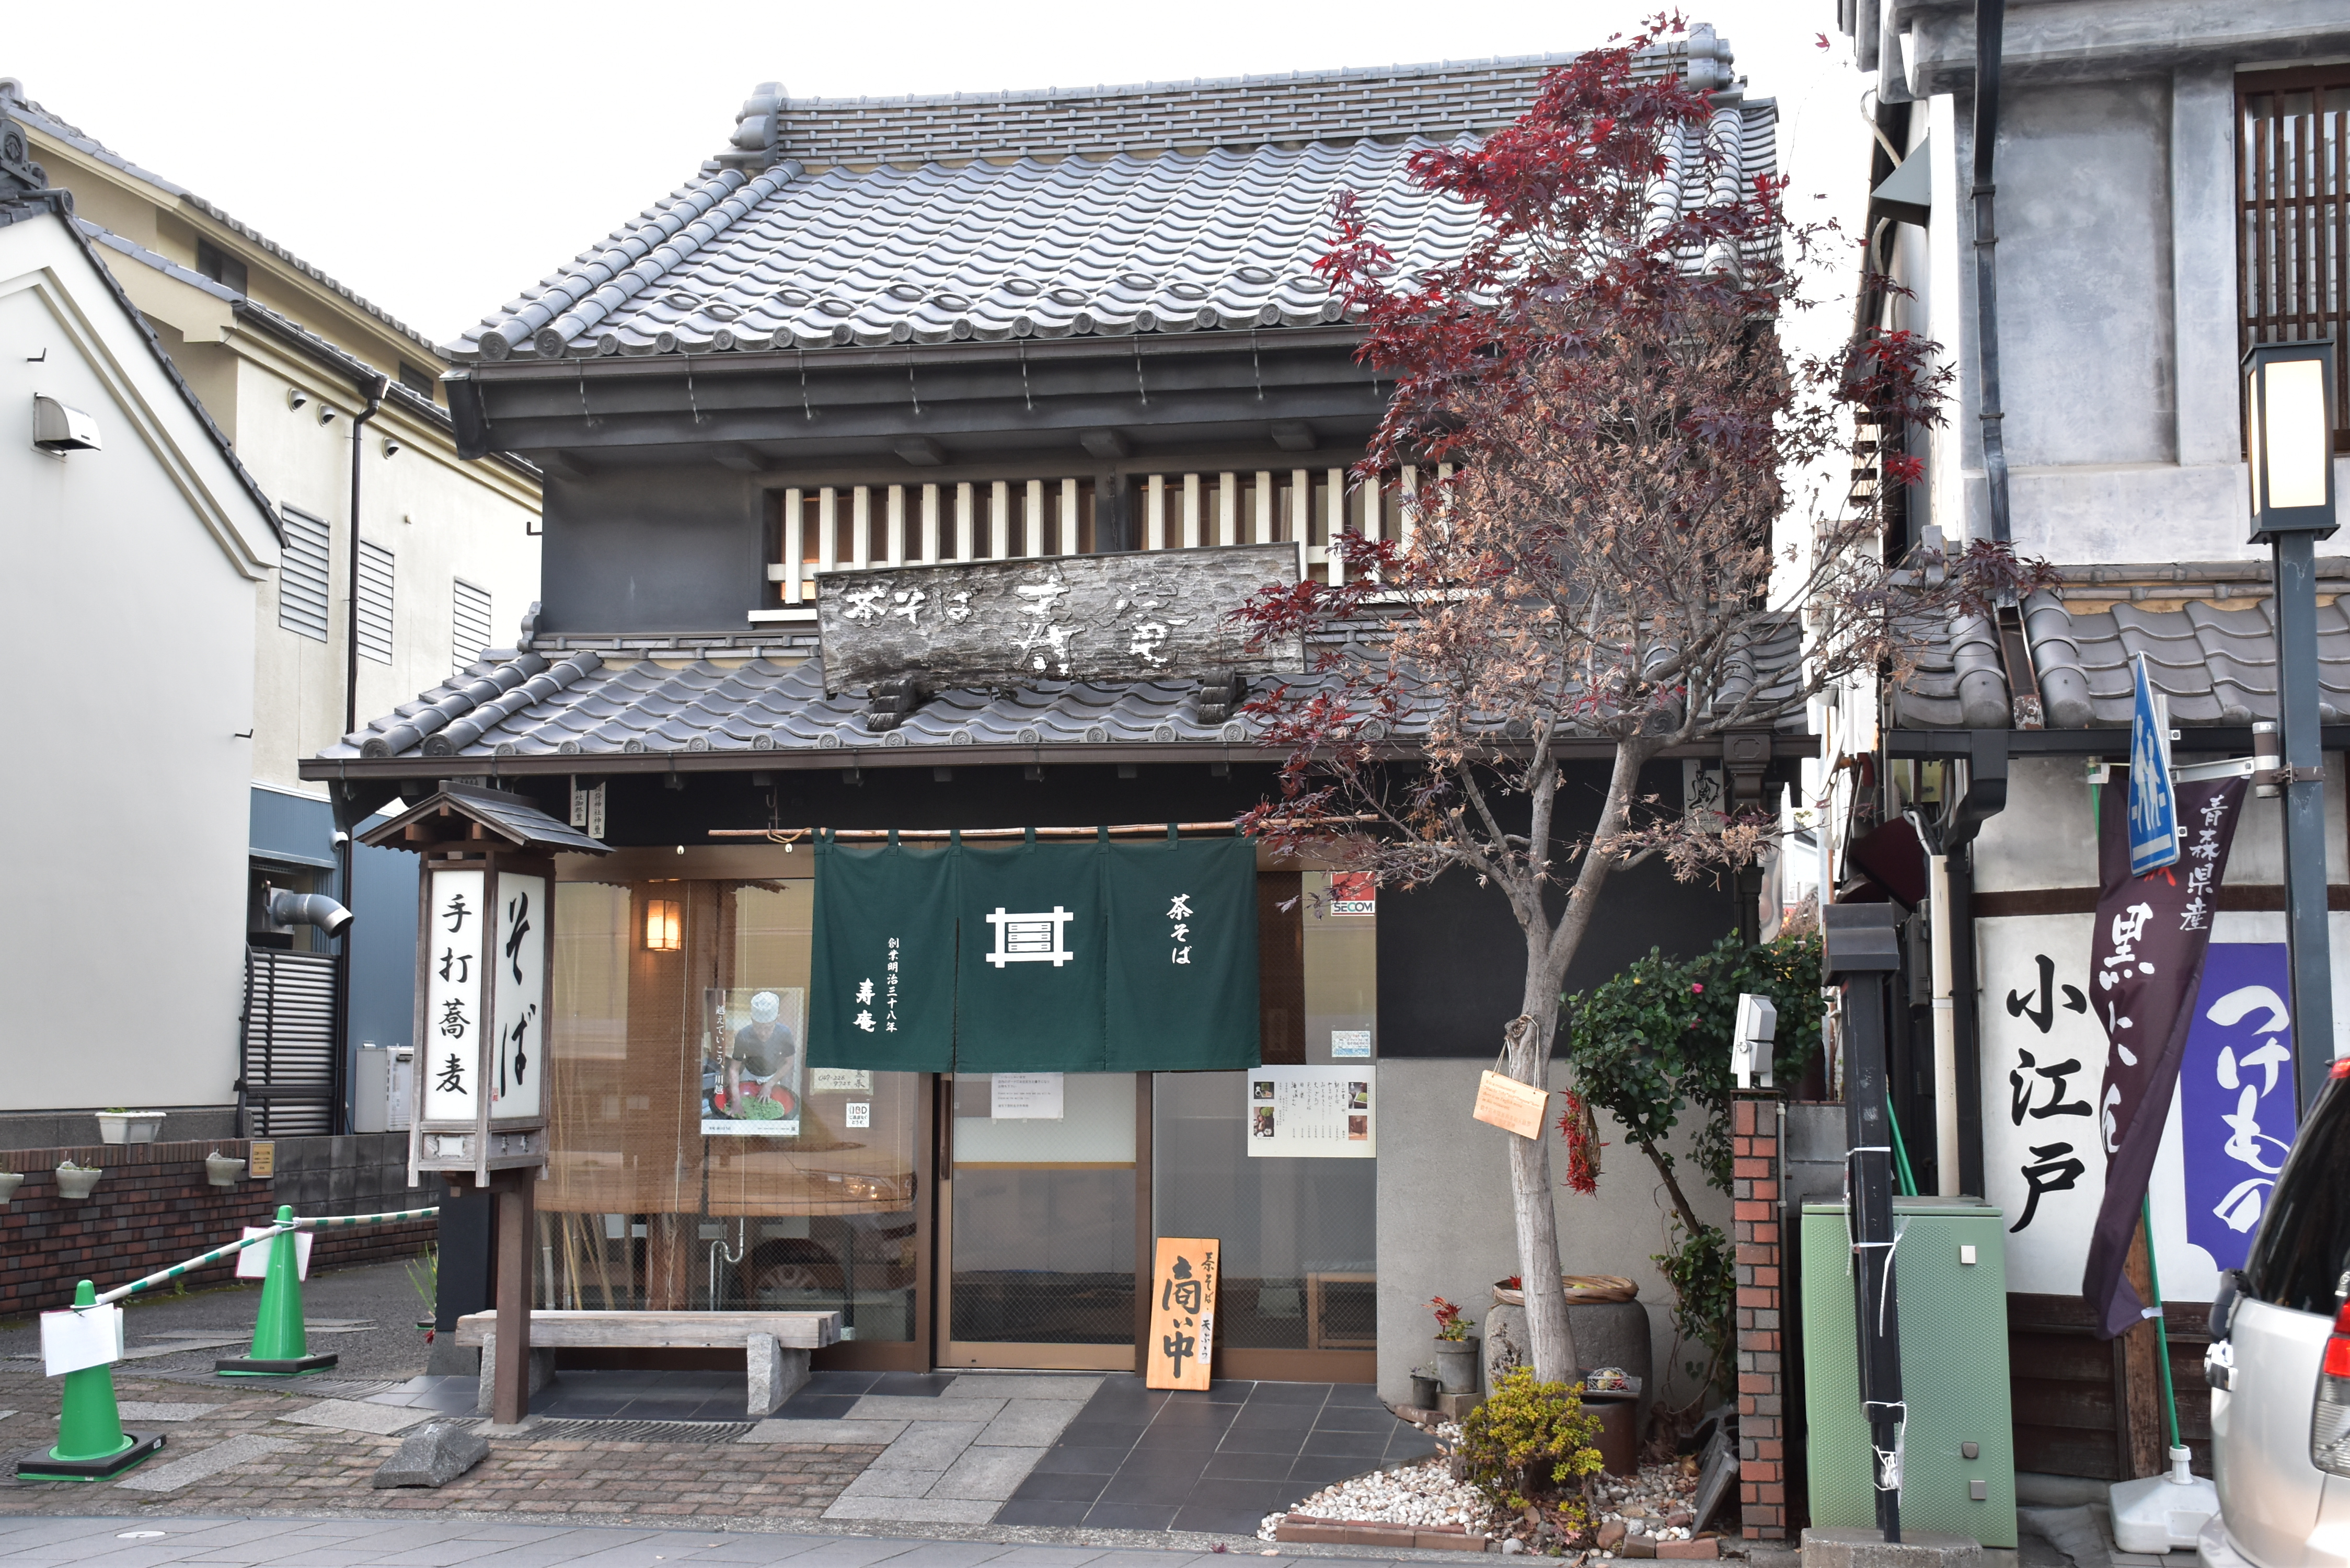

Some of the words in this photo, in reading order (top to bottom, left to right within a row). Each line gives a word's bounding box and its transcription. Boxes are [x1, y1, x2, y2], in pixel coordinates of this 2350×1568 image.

[843, 582, 984, 628] 茶そば
[1334, 902, 1373, 912] SECOM
[2180, 794, 2228, 931] 青森県産
[1166, 894, 1193, 964] 茶そば
[436, 894, 473, 1094] 手打蕎麦
[499, 892, 537, 1098] そば
[853, 978, 877, 1032] 寿庵
[886, 938, 899, 1033] 創業明治三十八年
[2006, 954, 2092, 1233] 小江戸
[1162, 1255, 1201, 1379] 商い中
